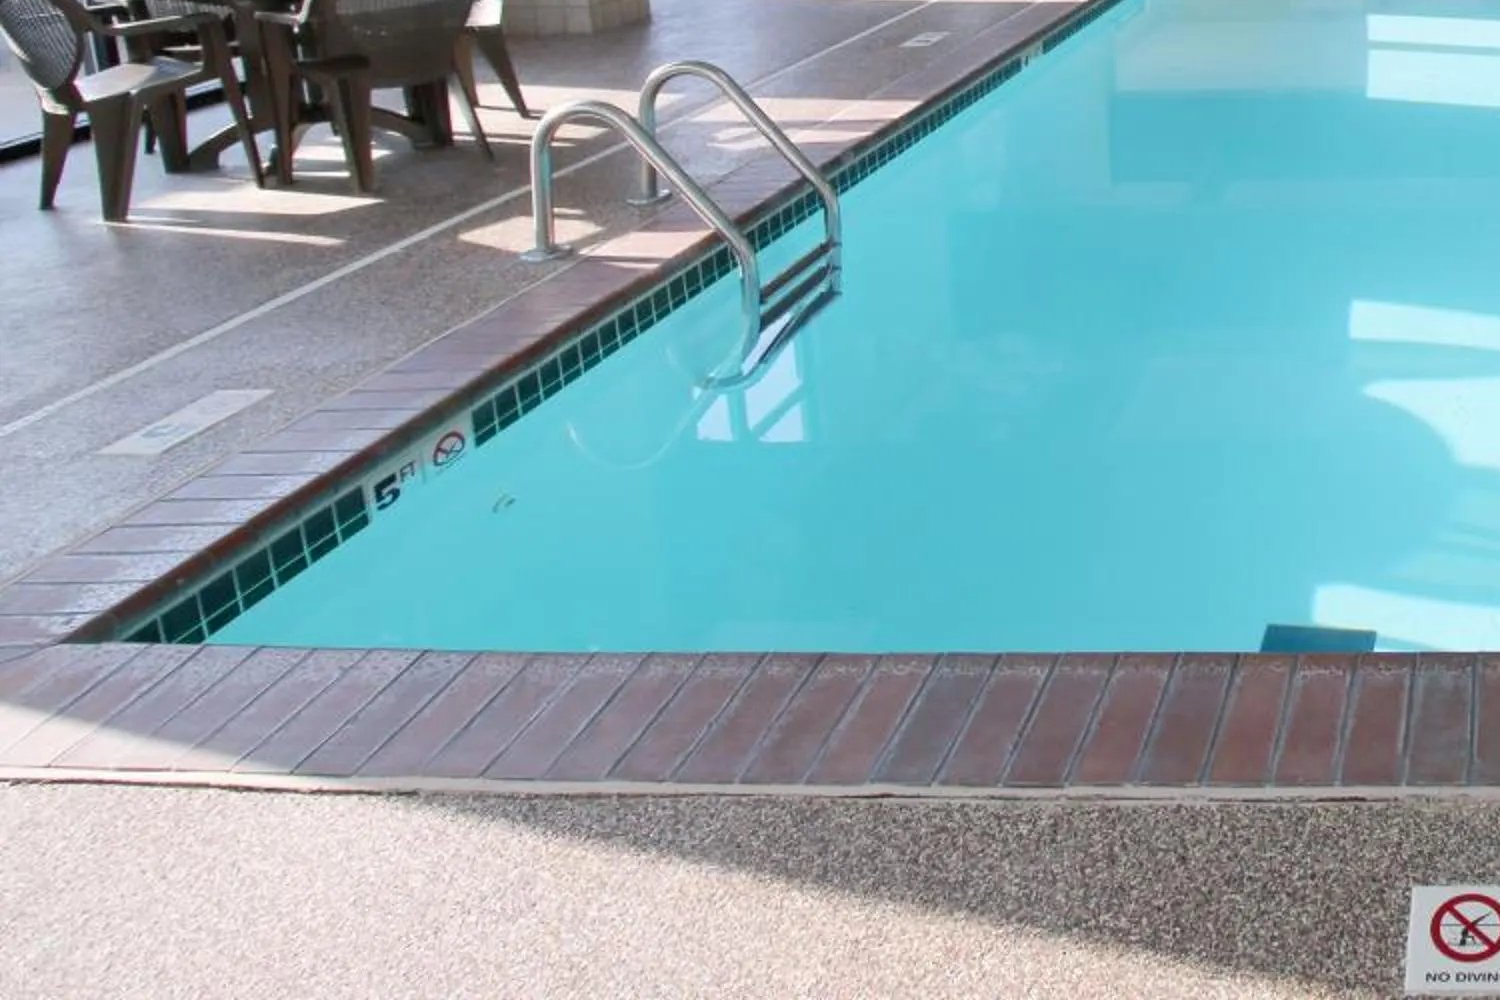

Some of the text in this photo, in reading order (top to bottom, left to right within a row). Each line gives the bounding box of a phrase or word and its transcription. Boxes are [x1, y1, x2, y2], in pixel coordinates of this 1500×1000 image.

[374, 460, 416, 511] 5 FT
[1425, 971, 1451, 983] NO
